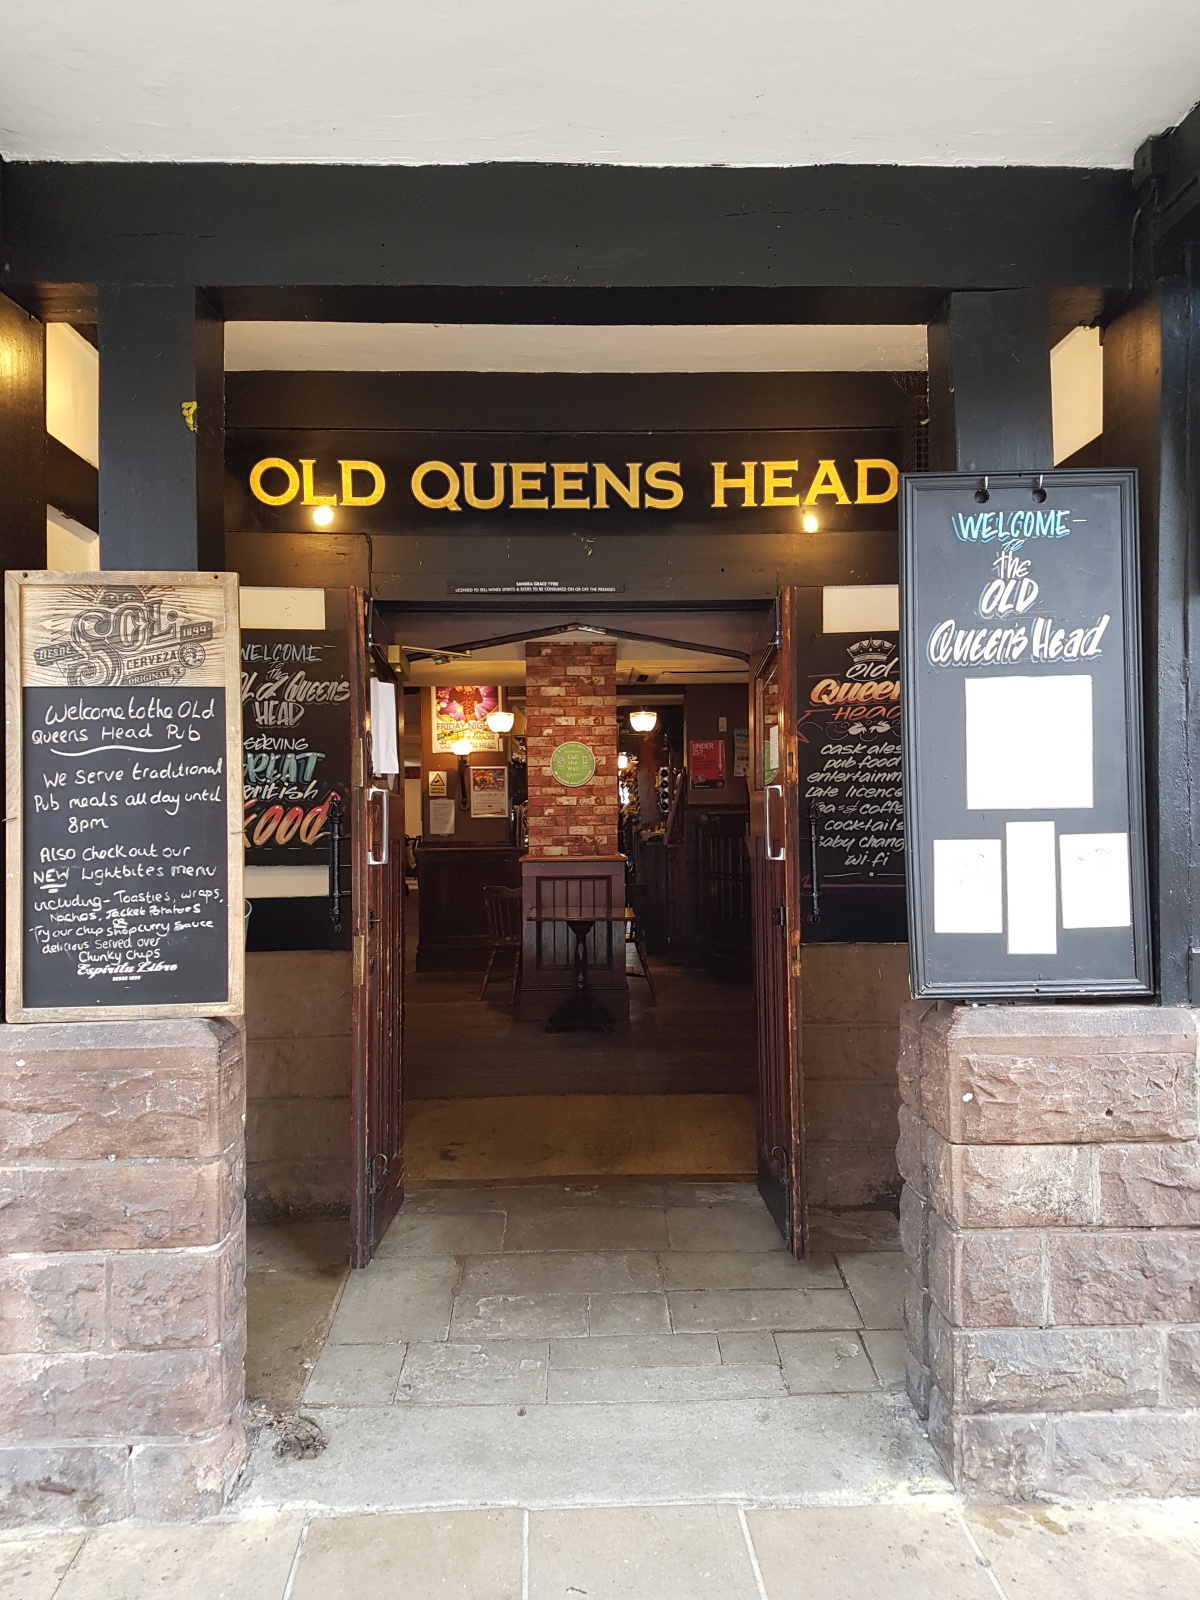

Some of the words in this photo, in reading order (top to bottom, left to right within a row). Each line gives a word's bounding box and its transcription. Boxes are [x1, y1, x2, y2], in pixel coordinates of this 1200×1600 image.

[249, 457, 386, 508] OLD
[411, 460, 685, 512] QUEENS
[711, 458, 899, 508] HEAD
[954, 510, 1071, 541] WELCOME
[980, 578, 1039, 616] OLD
[182, 626, 207, 638] 1899
[1032, 614, 1110, 660] Head
[126, 651, 178, 670] CERVEZA
[129, 671, 170, 685] ORIGINAL
[45, 697, 125, 725] Welcome
[254, 701, 304, 726] HEAD
[31, 728, 89, 745] Queens
[101, 722, 153, 741] Head
[165, 724, 201, 741] Pub
[437, 722, 465, 730] FRIDAY
[468, 722, 489, 730] NIGH
[243, 733, 309, 750] SERVING
[43, 770, 67, 788] We
[132, 757, 223, 781] traditional
[823, 756, 856, 771] pub
[858, 755, 901, 768] food
[807, 770, 902, 782] entertainm
[69, 791, 118, 809] meals
[150, 790, 180, 816] day
[185, 786, 221, 802] until
[68, 816, 109, 833] 8pm
[40, 847, 76, 863] Also
[128, 843, 159, 860] out
[162, 846, 191, 859] our
[33, 867, 70, 884] NEW
[171, 864, 217, 877] menu
[52, 928, 74, 937] our
[138, 922, 170, 937] curry
[137, 937, 161, 947] over
[136, 961, 178, 973] Libre
